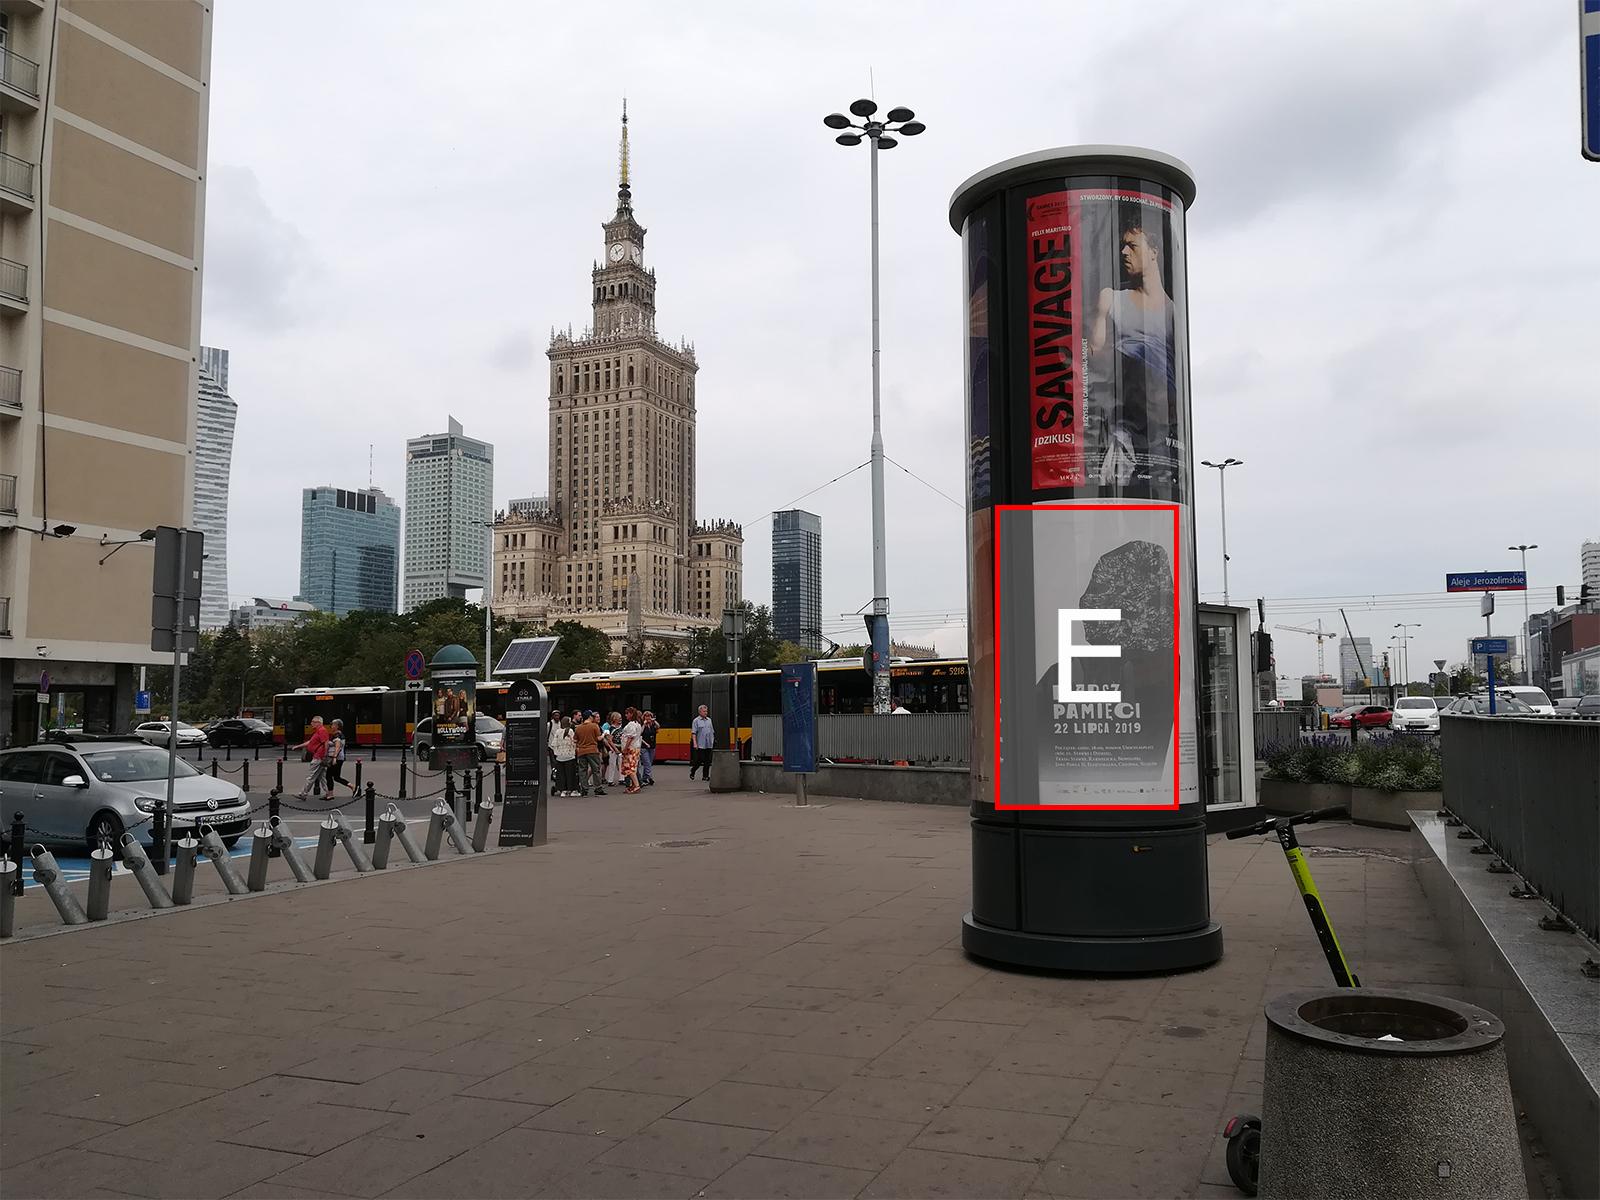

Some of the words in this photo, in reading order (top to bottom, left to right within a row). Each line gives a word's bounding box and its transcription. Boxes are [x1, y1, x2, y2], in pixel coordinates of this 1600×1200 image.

[1031, 229, 1045, 238] FELIX
[1034, 234, 1075, 429] SAUVAGE
[1451, 578, 1471, 587] Aleje
[1473, 576, 1524, 585] Jerozolimskie
[1053, 702, 1140, 721] PAMIĘCI
[437, 726, 467, 734] HOLLYWOOD
[1054, 722, 1069, 734] 22
[1074, 722, 1110, 734] LIPCA
[1115, 722, 1141, 734] 2019
